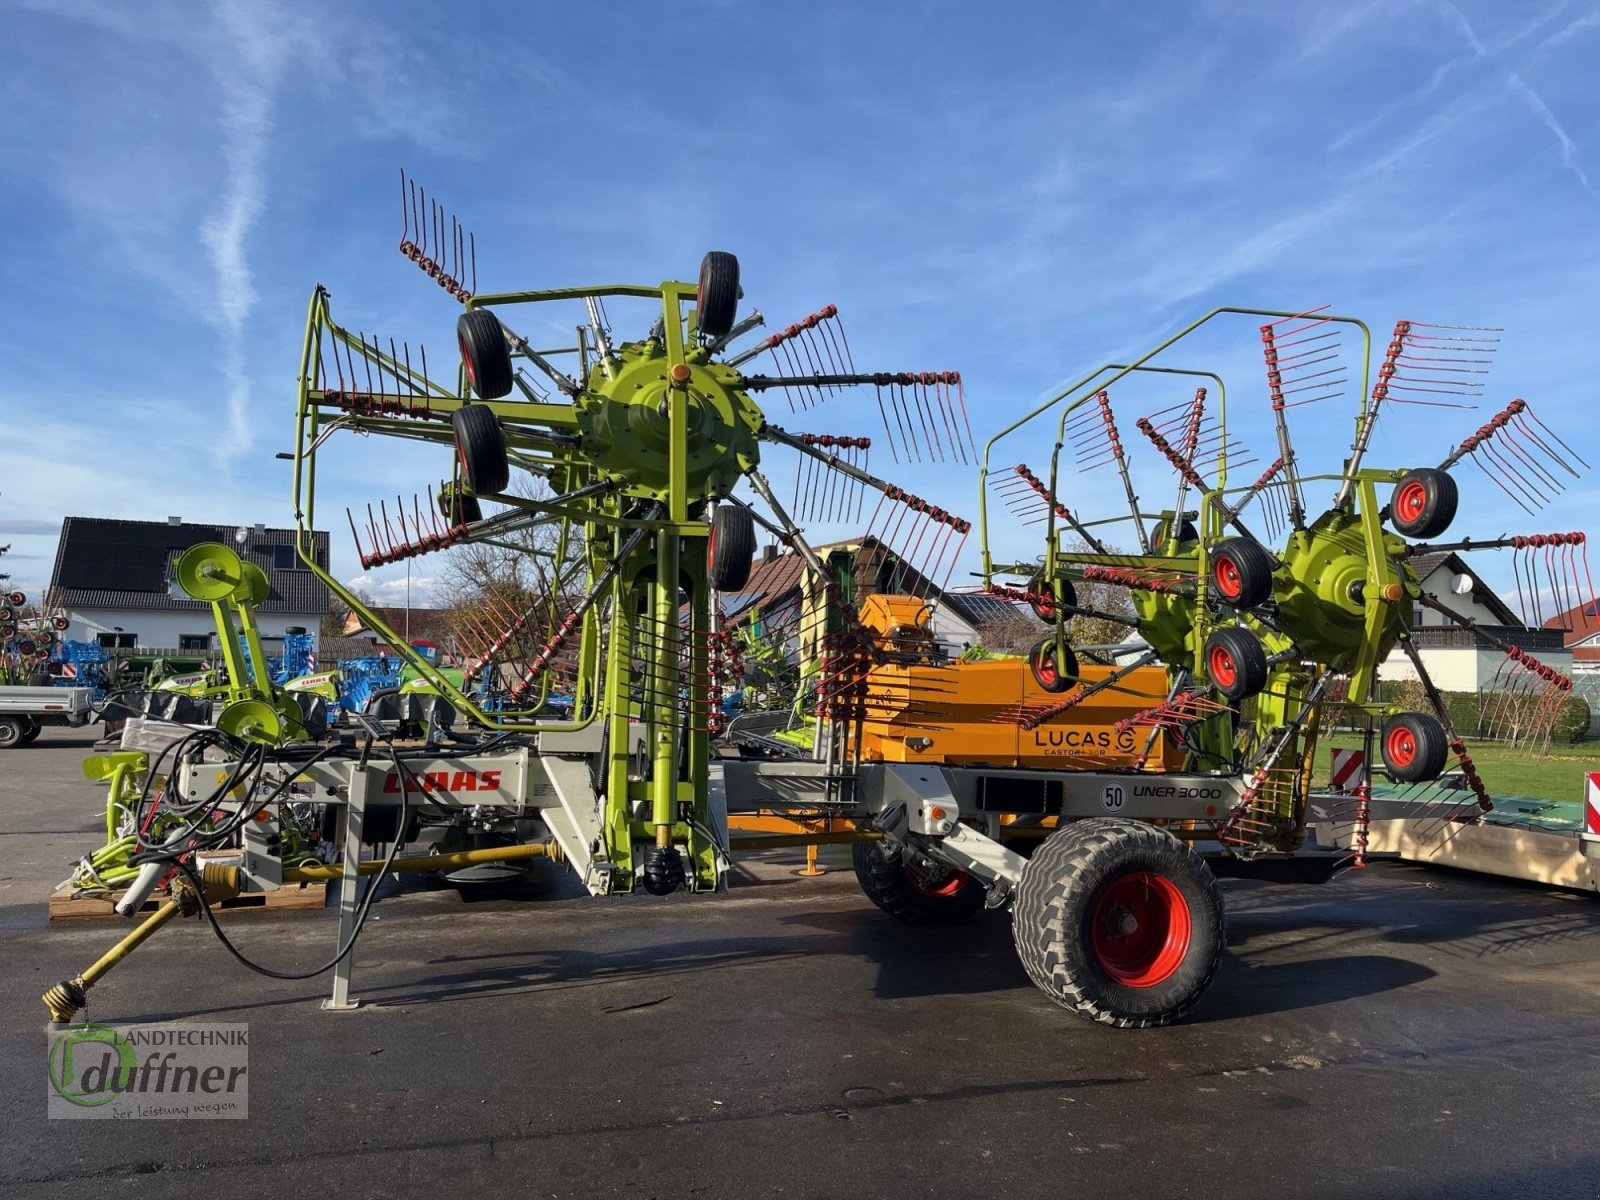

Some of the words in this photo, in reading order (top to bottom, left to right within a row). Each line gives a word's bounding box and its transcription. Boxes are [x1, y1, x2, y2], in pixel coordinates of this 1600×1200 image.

[1035, 731, 1111, 747] LUCAS
[383, 770, 502, 793] CLAAS
[1105, 787, 1123, 807] 50
[1178, 787, 1222, 799] 3000
